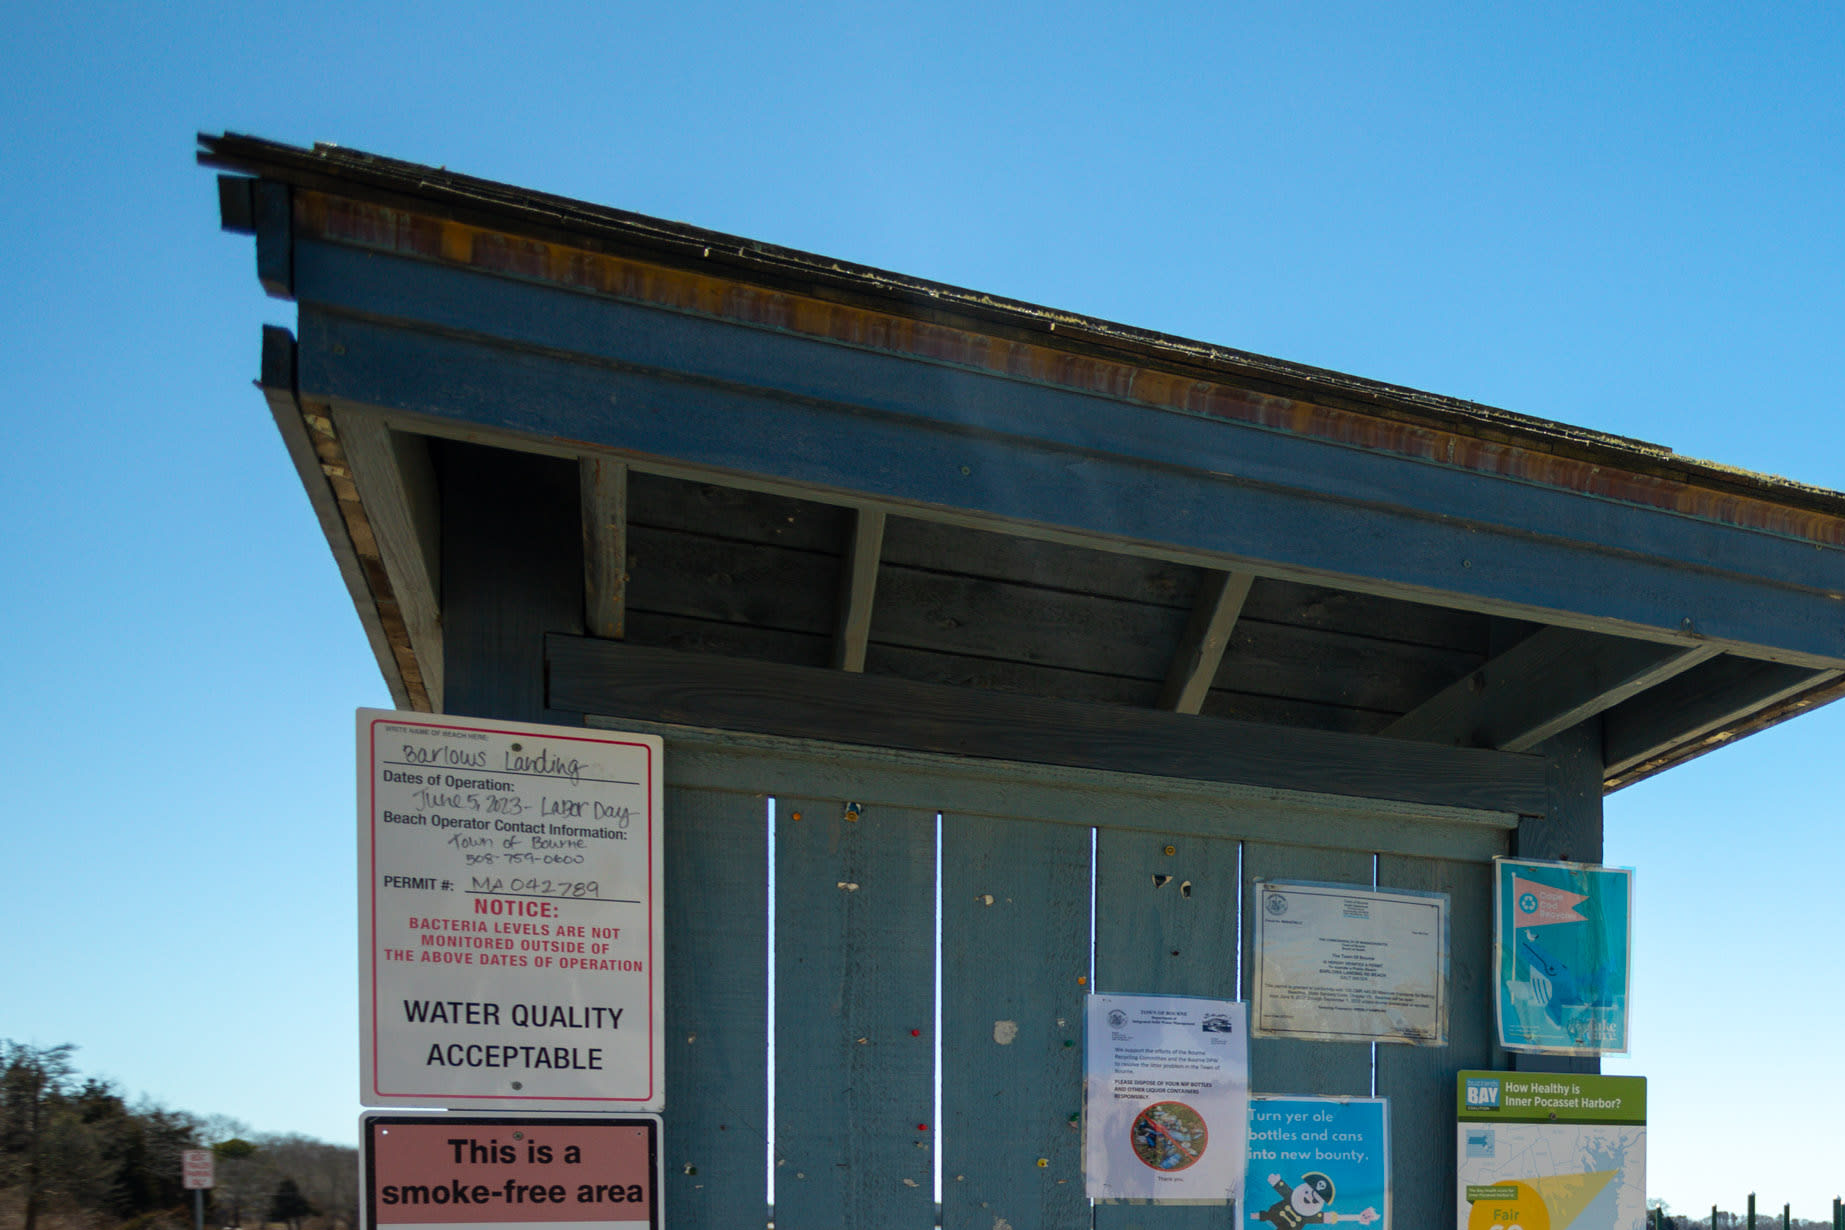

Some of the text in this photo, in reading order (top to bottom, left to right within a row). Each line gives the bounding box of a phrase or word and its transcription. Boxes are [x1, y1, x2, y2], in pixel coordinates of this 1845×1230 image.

[403, 745, 588, 787] Barlows Landing
[383, 769, 514, 792] Dates of Operation:
[383, 811, 628, 840] Beach Operator Contact Information:
[448, 833, 586, 850] Town of Bourne
[384, 875, 455, 892] PERMIT #:
[474, 898, 559, 919] NOTICE:
[409, 917, 621, 939] BACTERIA LEVELS ARE NOT
[421, 934, 610, 954] MONITORED OUTSIDE OF
[384, 949, 643, 972] THE ABOVE DATES OF OPERATION
[403, 999, 624, 1030] WATER QUALITY
[426, 1043, 603, 1070] ACCEPTABLE
[1467, 1087, 1498, 1104] BAY
[1505, 1082, 1580, 1095] How Healthy is
[1505, 1096, 1622, 1108] Inner Pocasset Harbor?
[1248, 1109, 1334, 1124] Turn yer ole
[1248, 1128, 1363, 1141] bottles and cans
[448, 1138, 581, 1164] This is a
[1248, 1148, 1368, 1163] into new bounty.
[382, 1179, 643, 1205] smoke-free area
[1493, 1209, 1519, 1220] Fair
